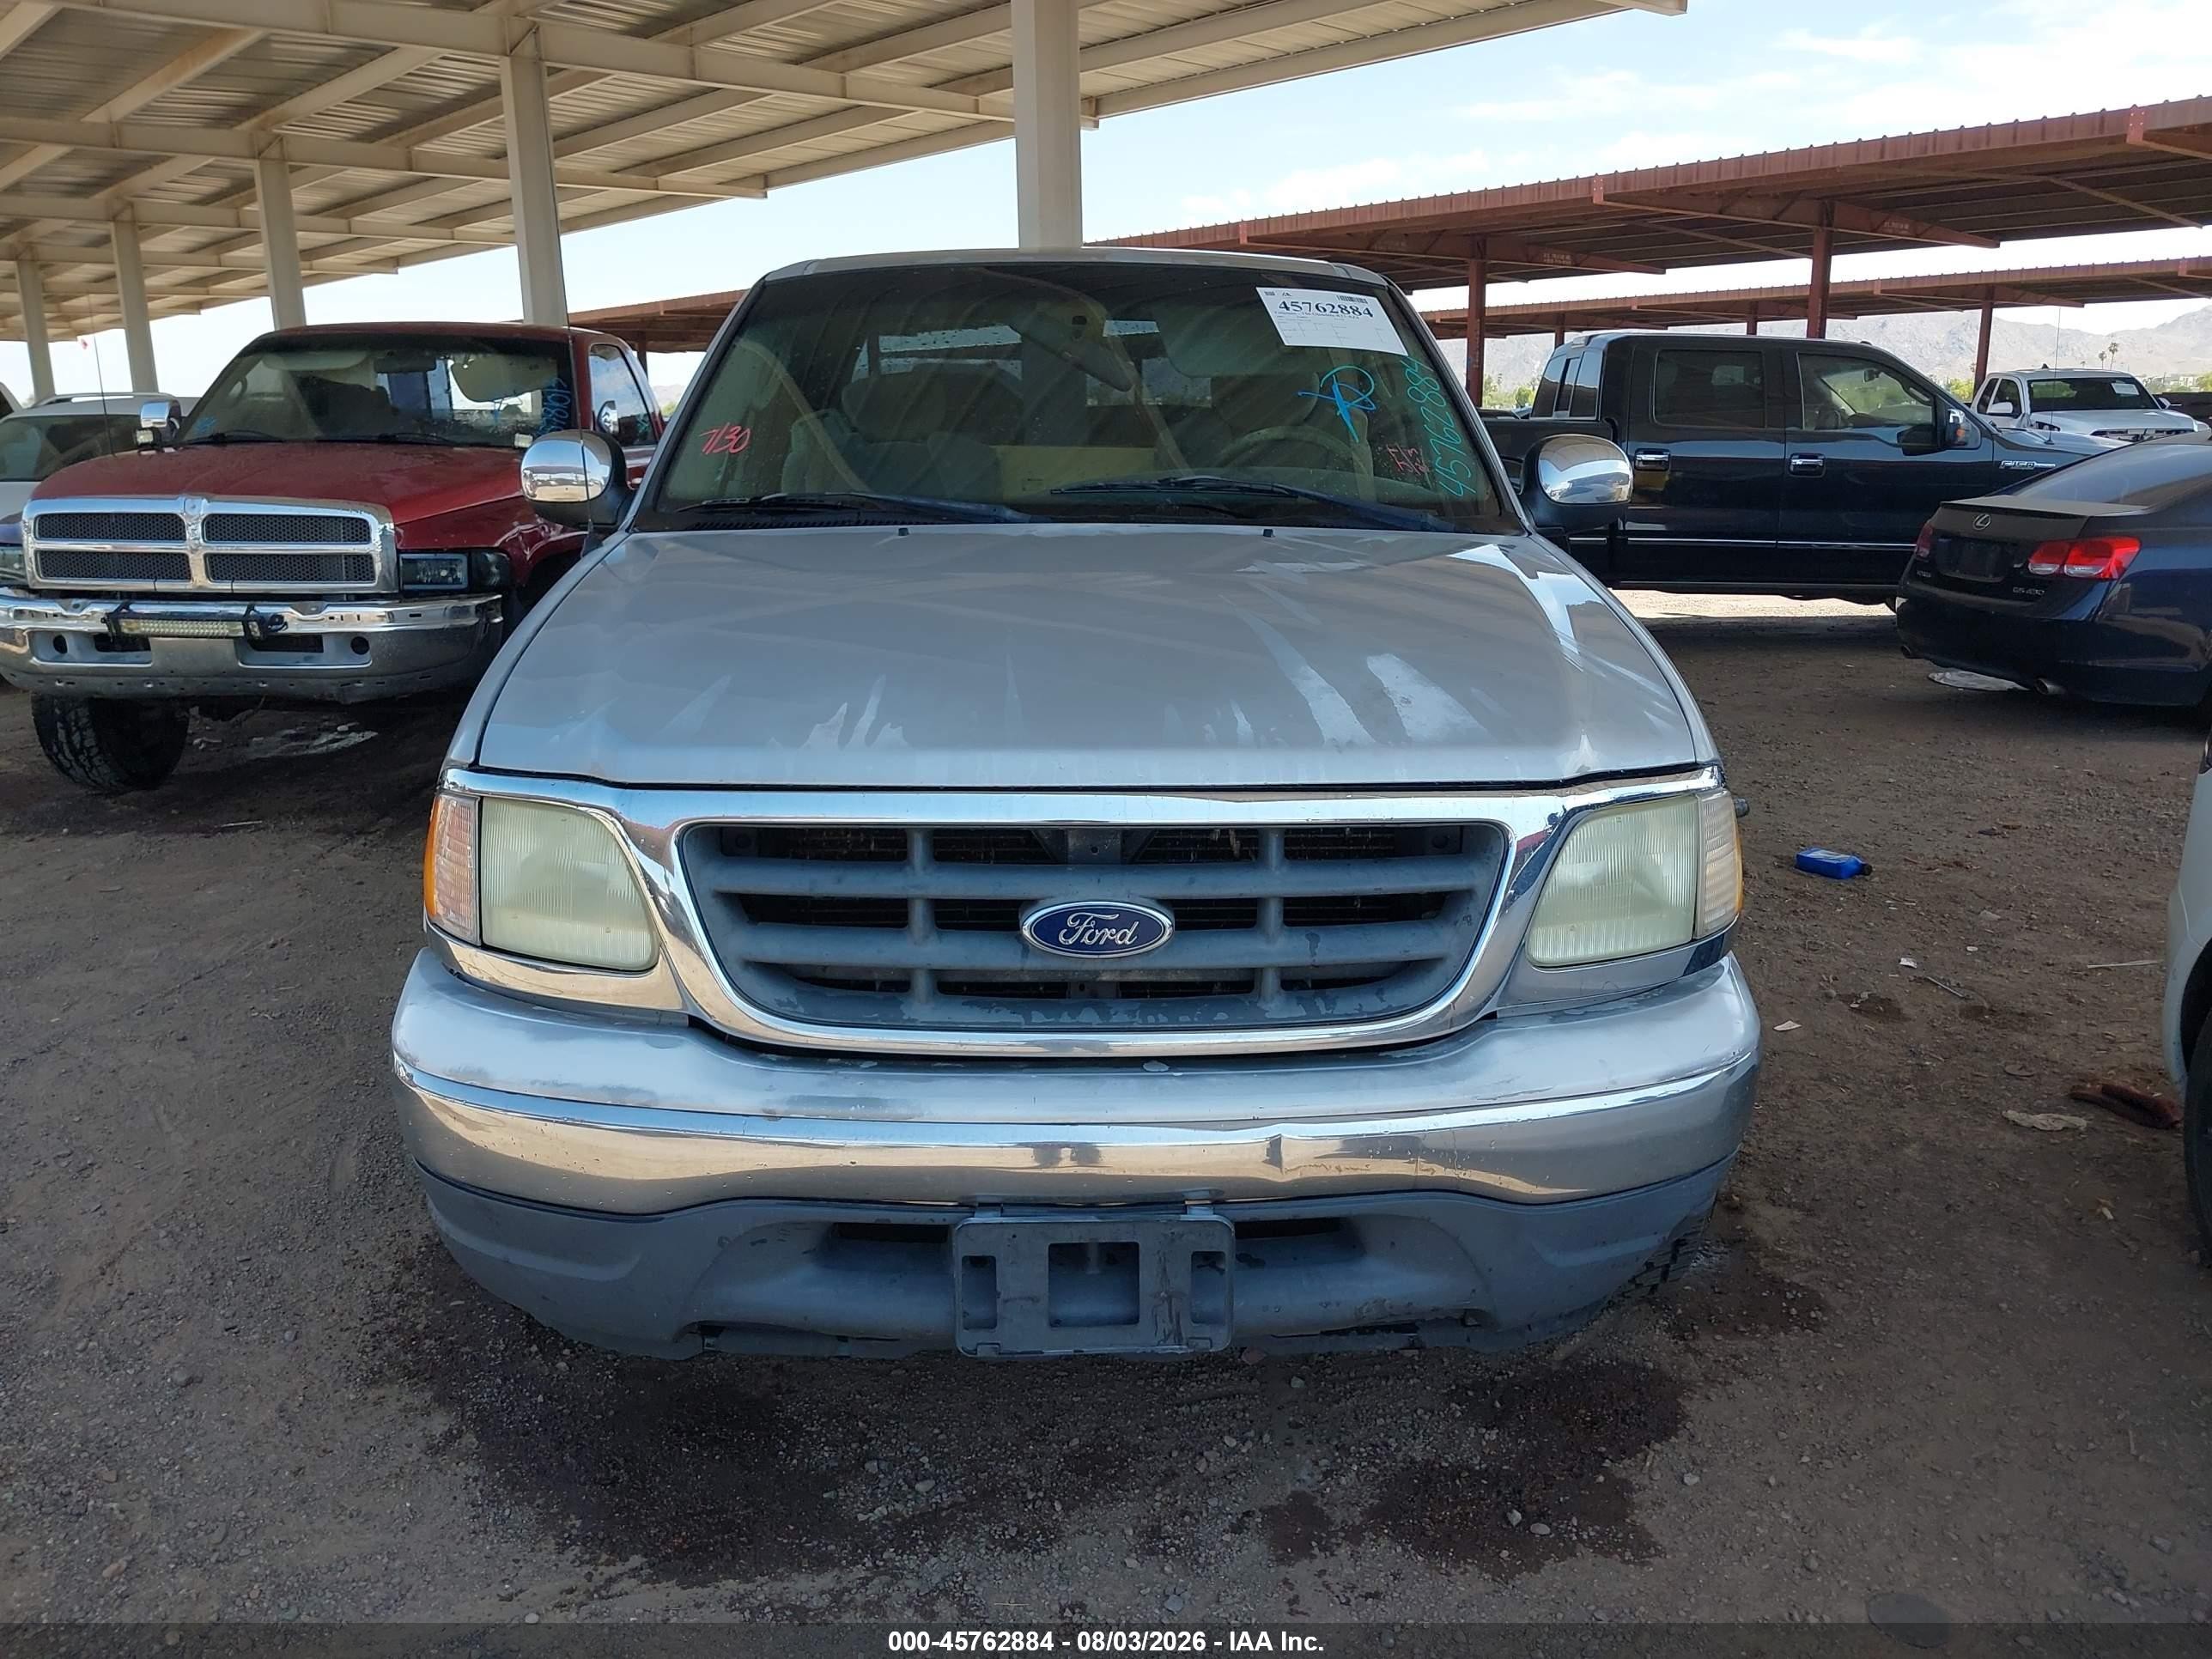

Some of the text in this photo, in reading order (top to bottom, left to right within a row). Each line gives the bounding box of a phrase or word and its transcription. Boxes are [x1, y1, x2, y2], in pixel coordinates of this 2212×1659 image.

[1279, 300, 1374, 319] 45762884
[698, 422, 751, 455] 7/30
[1401, 356, 1477, 496] 45762884
[1059, 912, 1139, 945] Ford
